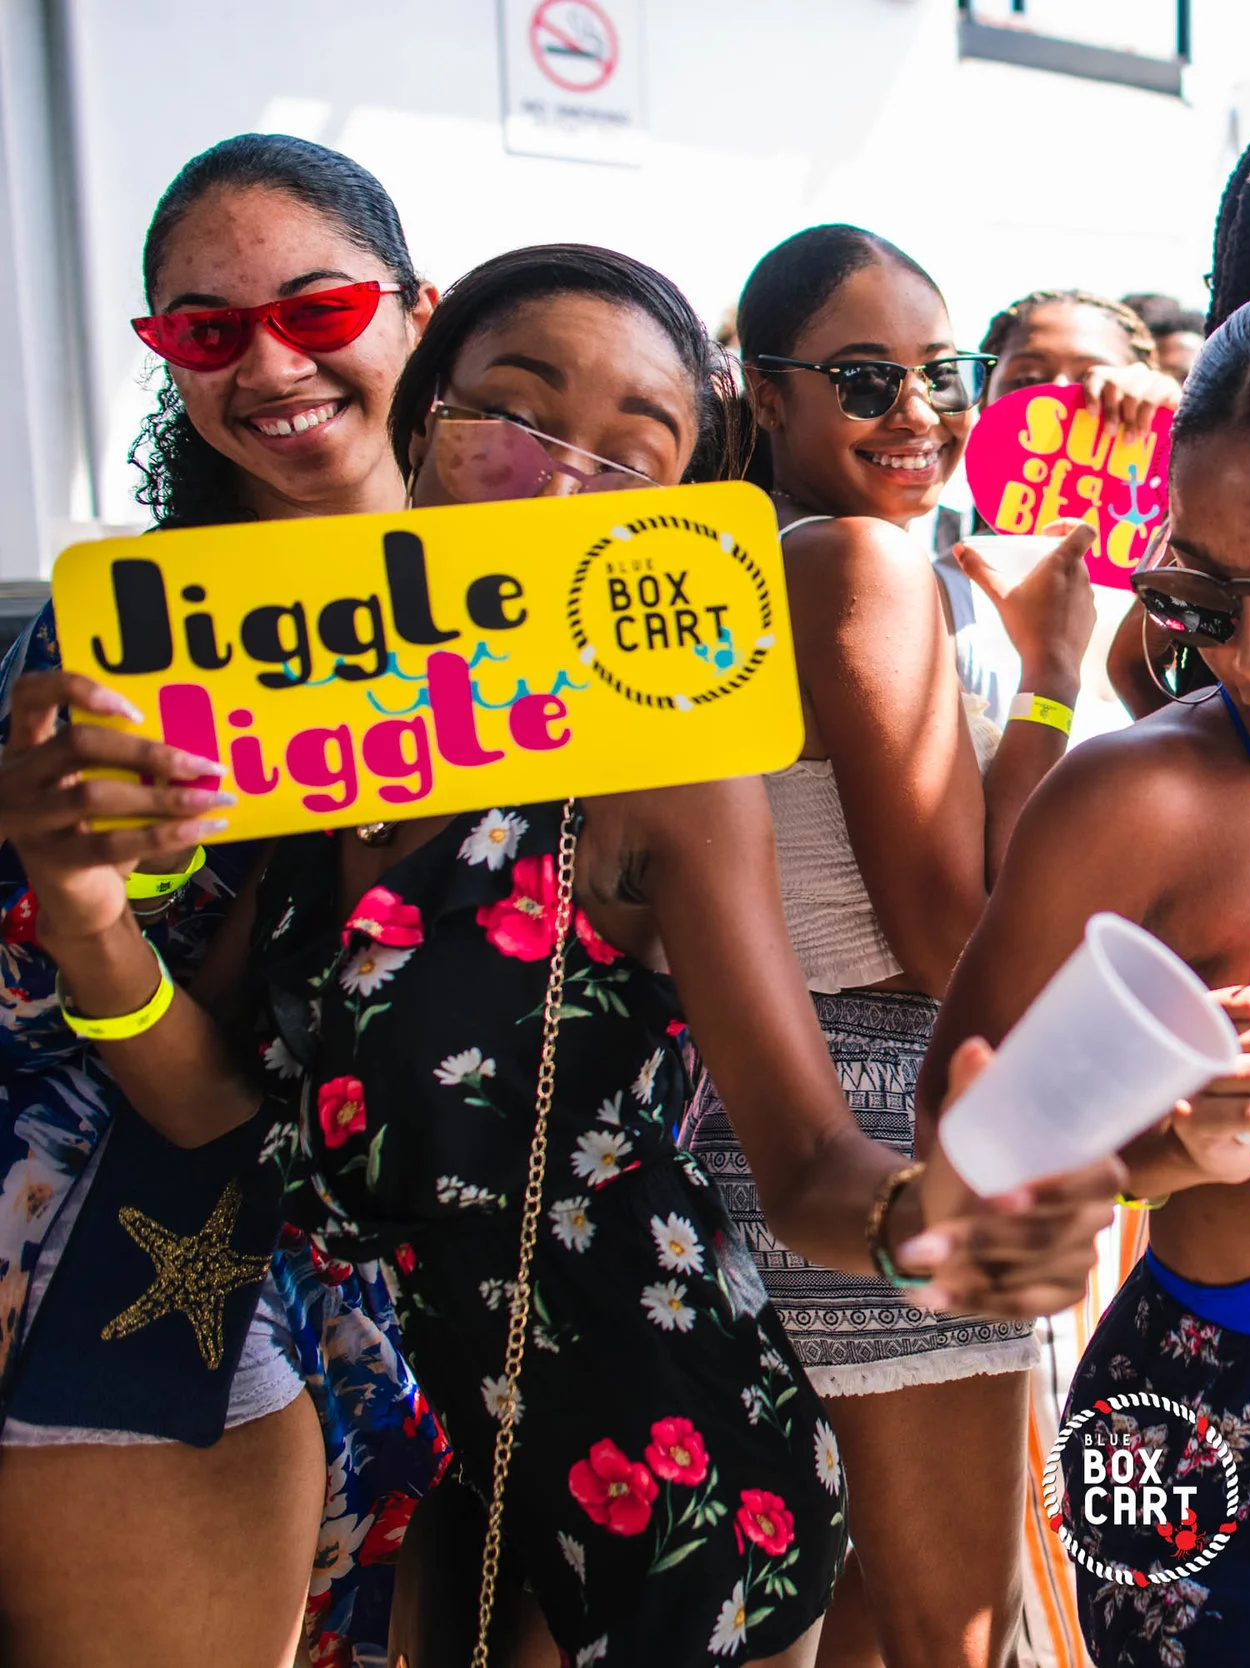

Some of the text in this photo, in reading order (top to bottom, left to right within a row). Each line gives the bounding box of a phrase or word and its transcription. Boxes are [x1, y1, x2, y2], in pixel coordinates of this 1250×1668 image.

[1076, 475, 1103, 508] a
[92, 531, 528, 688] Jiggle
[609, 571, 690, 612] BOX
[615, 605, 729, 652] CART
